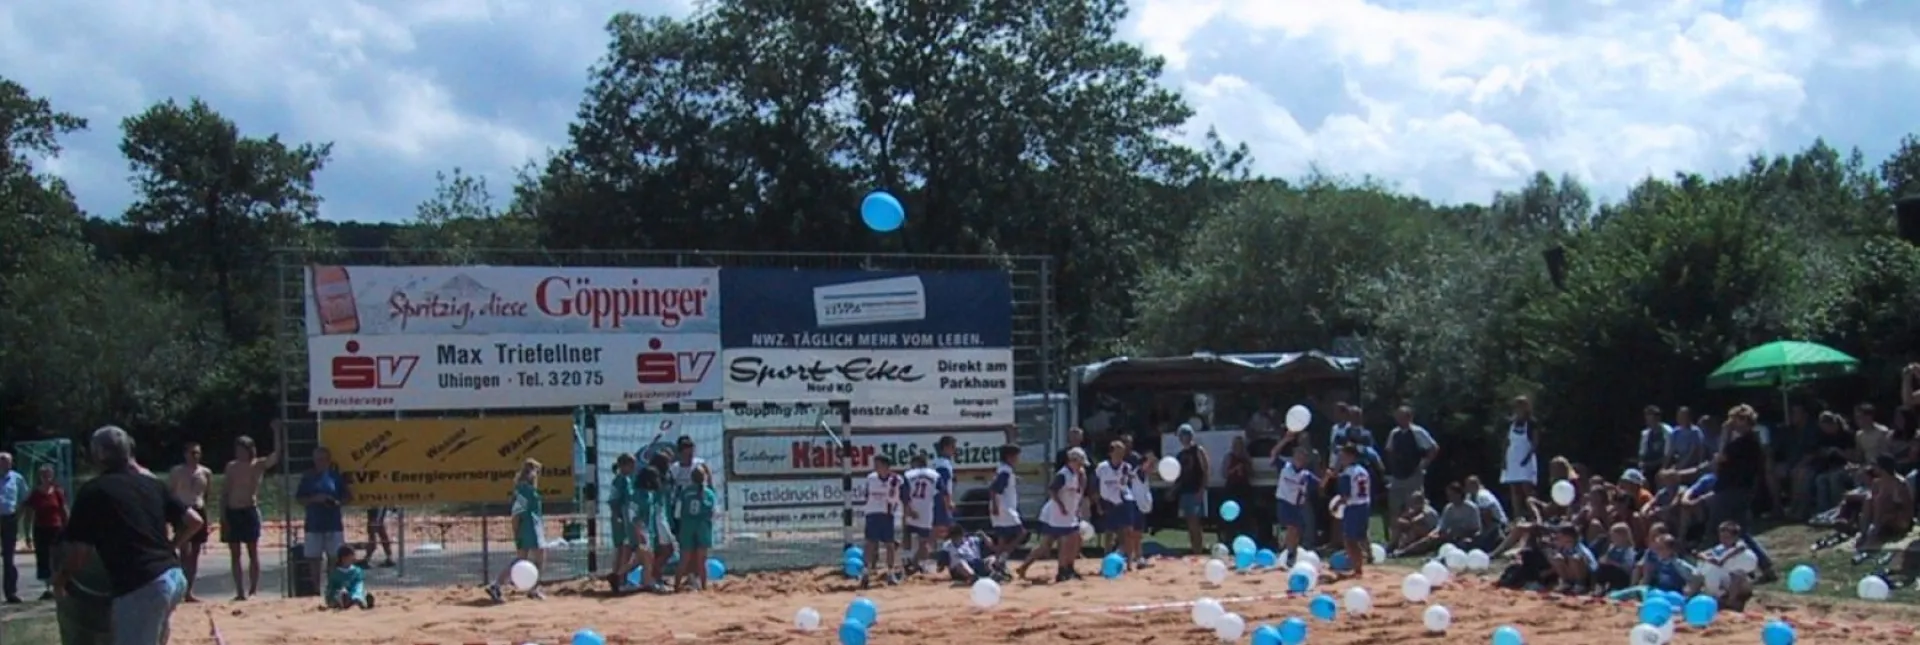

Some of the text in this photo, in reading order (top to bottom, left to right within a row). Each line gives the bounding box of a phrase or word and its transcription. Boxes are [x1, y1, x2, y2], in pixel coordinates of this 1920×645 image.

[535, 275, 708, 328] Göppinger
[752, 332, 985, 347] NWZ. TÄGLICH MEHR VOM LEBEN.
[437, 342, 603, 365] Max Triefellner
[729, 356, 832, 387] Sport
[937, 359, 1008, 374] Direkt am
[438, 370, 604, 390] Uhingen Tel. 32075
[940, 374, 1007, 390] Parkhaus
[912, 402, 930, 416] 42
